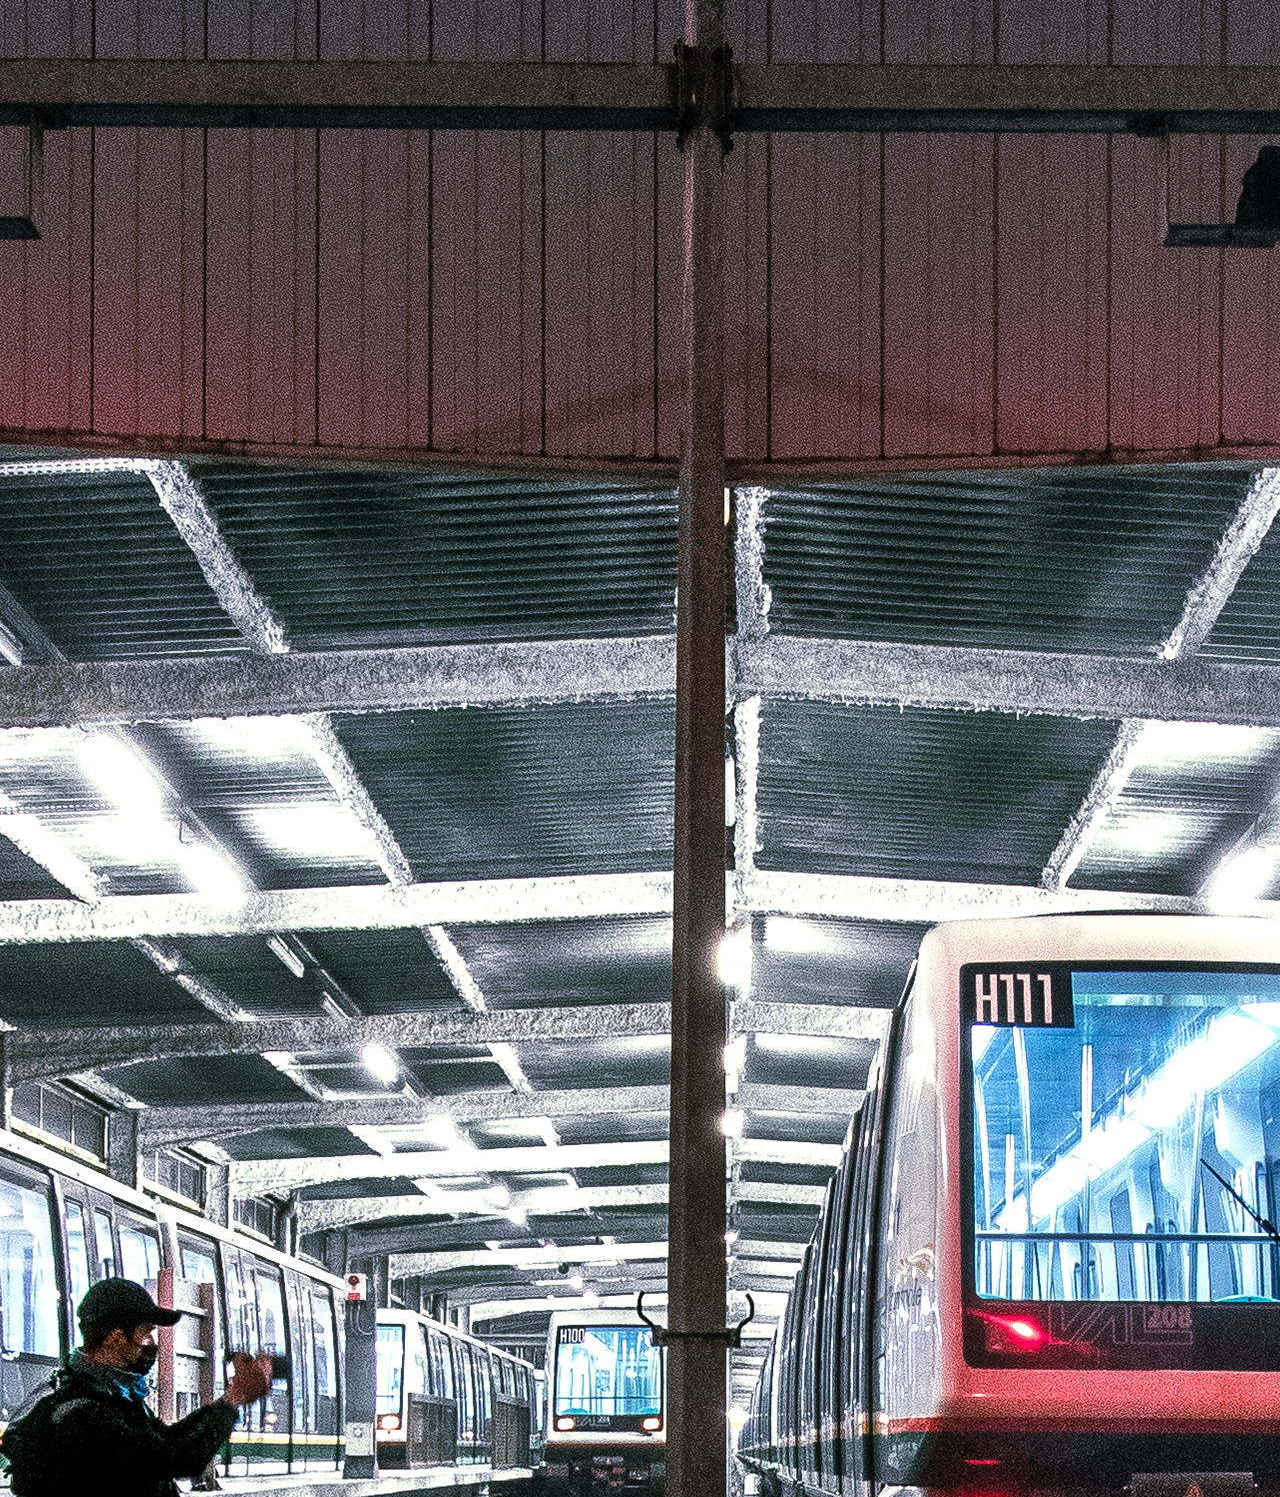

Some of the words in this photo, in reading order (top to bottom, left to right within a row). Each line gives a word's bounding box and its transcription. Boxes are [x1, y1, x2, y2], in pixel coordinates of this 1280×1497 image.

[975, 973, 1053, 1024] H111
[1147, 1304, 1193, 1329] 208
[560, 1328, 585, 1343] H100
